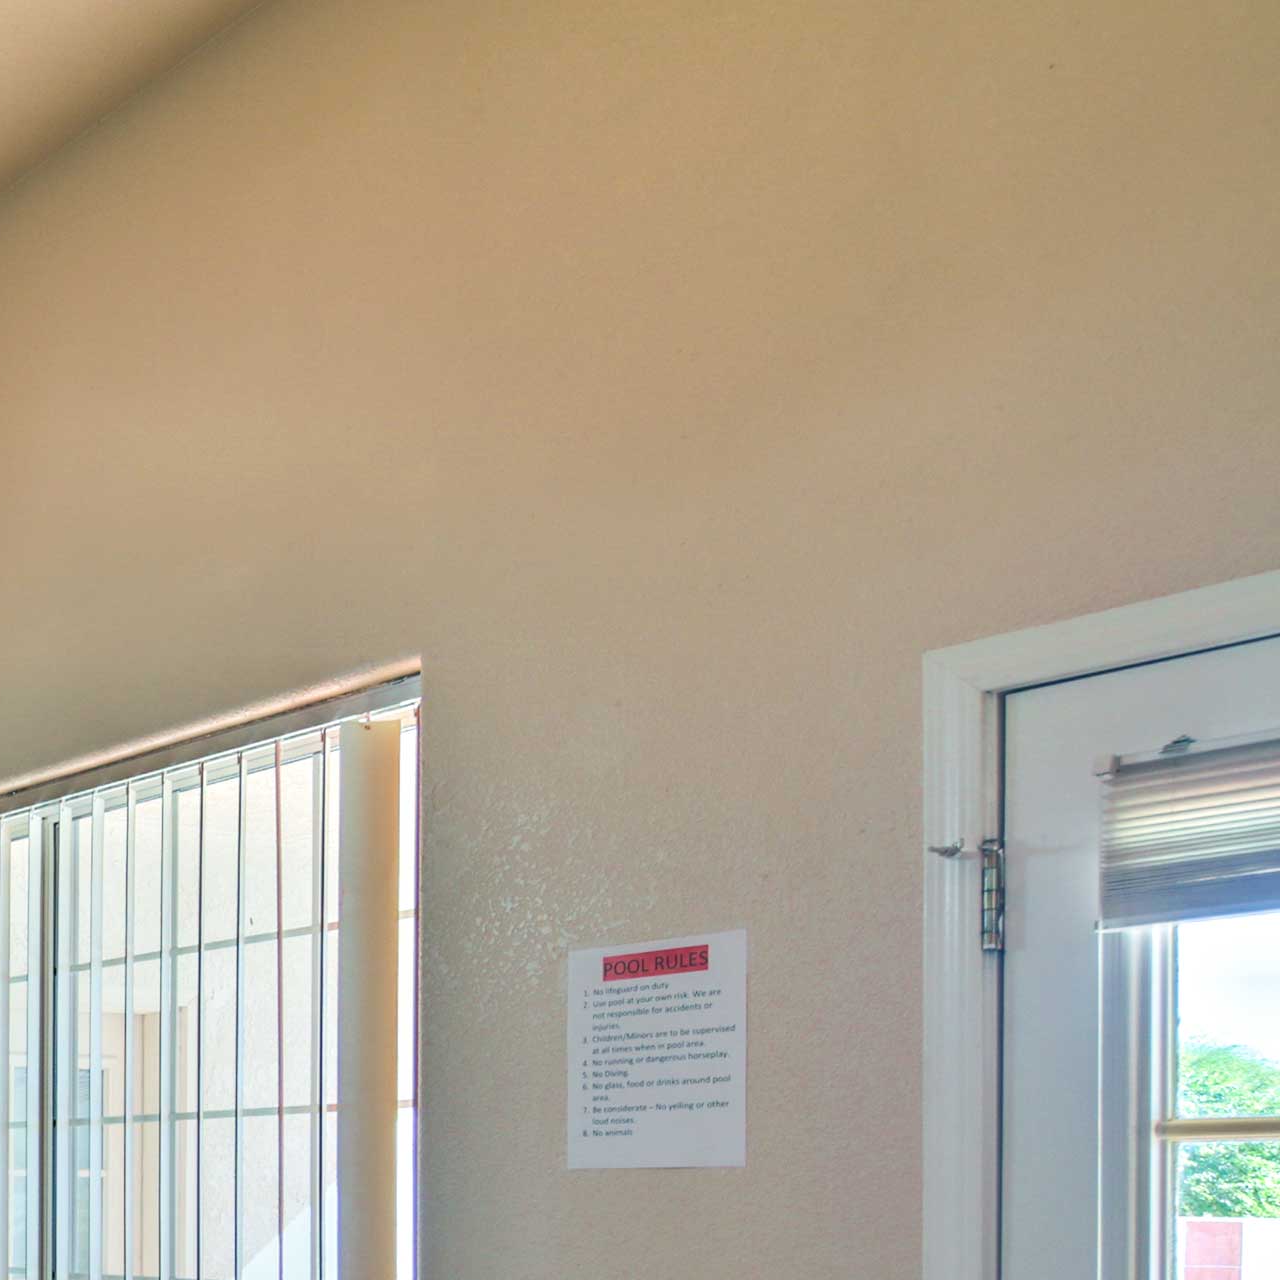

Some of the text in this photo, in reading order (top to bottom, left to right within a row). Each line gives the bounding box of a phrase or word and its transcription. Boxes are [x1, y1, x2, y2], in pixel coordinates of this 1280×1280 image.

[603, 951, 709, 977] POOL RULES
[651, 982, 669, 991] duty
[608, 998, 624, 1007] pool
[636, 996, 653, 1004] your
[606, 1007, 649, 1019] responsible
[664, 1003, 702, 1013] accidents
[592, 1032, 653, 1042] Children/Minors
[692, 1024, 736, 1035] supervised
[612, 1045, 632, 1053] times
[634, 1043, 655, 1052] when
[666, 1041, 684, 1050] pool
[605, 1057, 633, 1065] running
[645, 1053, 686, 1064] dangerous
[626, 1079, 644, 1088] food
[656, 1077, 680, 1086] drinks
[681, 1076, 711, 1084] around
[712, 1074, 731, 1084] pool
[604, 1104, 647, 1113] considerate
[669, 1101, 694, 1111] yelling
[707, 1100, 729, 1108] other
[592, 1116, 608, 1125] loud
